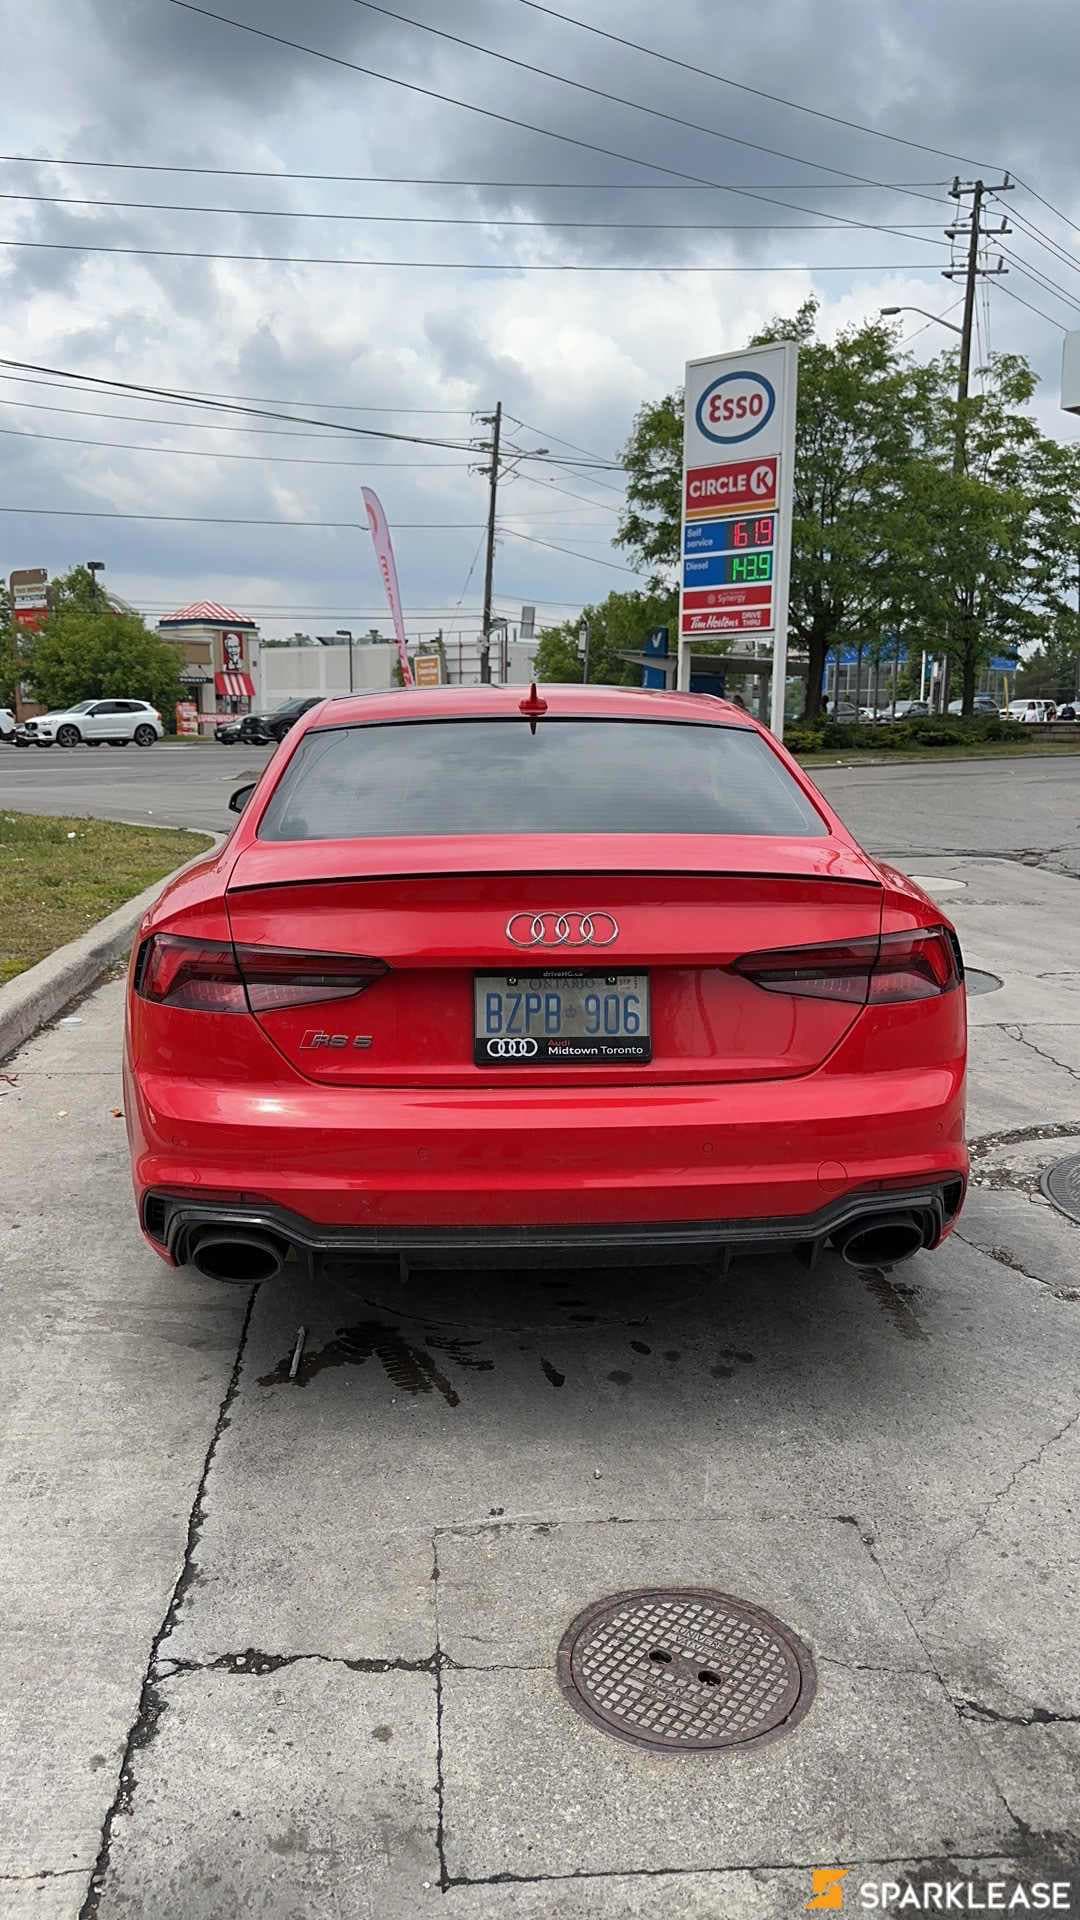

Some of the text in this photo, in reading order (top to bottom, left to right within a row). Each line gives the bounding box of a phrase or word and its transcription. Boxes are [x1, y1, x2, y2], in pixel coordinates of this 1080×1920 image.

[689, 470, 771, 498] CIRCLE K
[687, 527, 702, 538] Self
[686, 561, 709, 571] Diesel
[690, 615, 739, 629] Tim Hortons
[486, 992, 641, 1035] BZPB 906
[548, 1039, 570, 1047] Audi
[548, 1046, 643, 1056] Midtown Toronto
